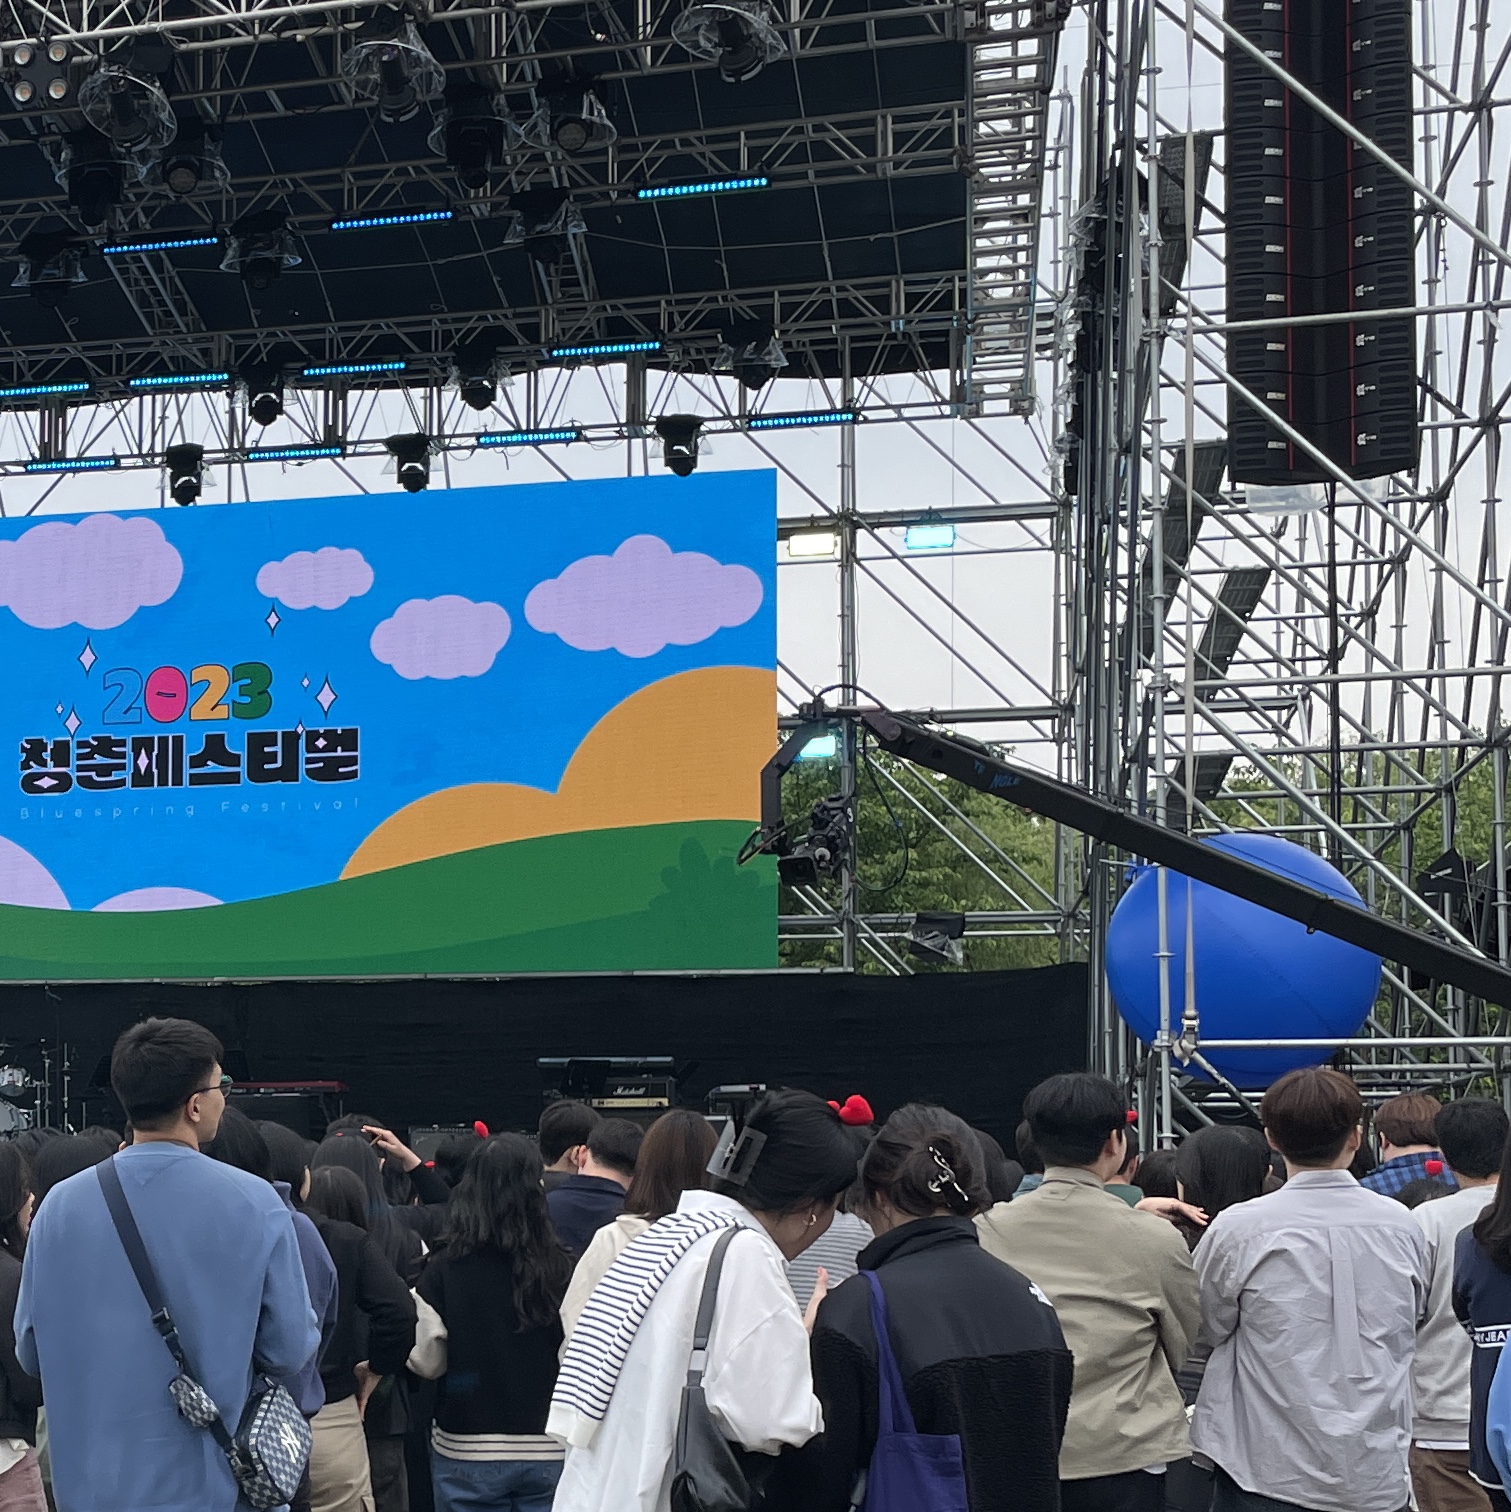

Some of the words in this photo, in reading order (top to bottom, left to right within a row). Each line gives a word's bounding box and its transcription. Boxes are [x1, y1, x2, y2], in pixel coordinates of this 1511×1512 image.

[102, 662, 273, 725] 2023
[19, 727, 360, 795] 청춘페스티벌
[20, 805, 194, 819] Bluespring
[221, 797, 358, 813] Festival
[1485, 1330, 1510, 1342] JEA
